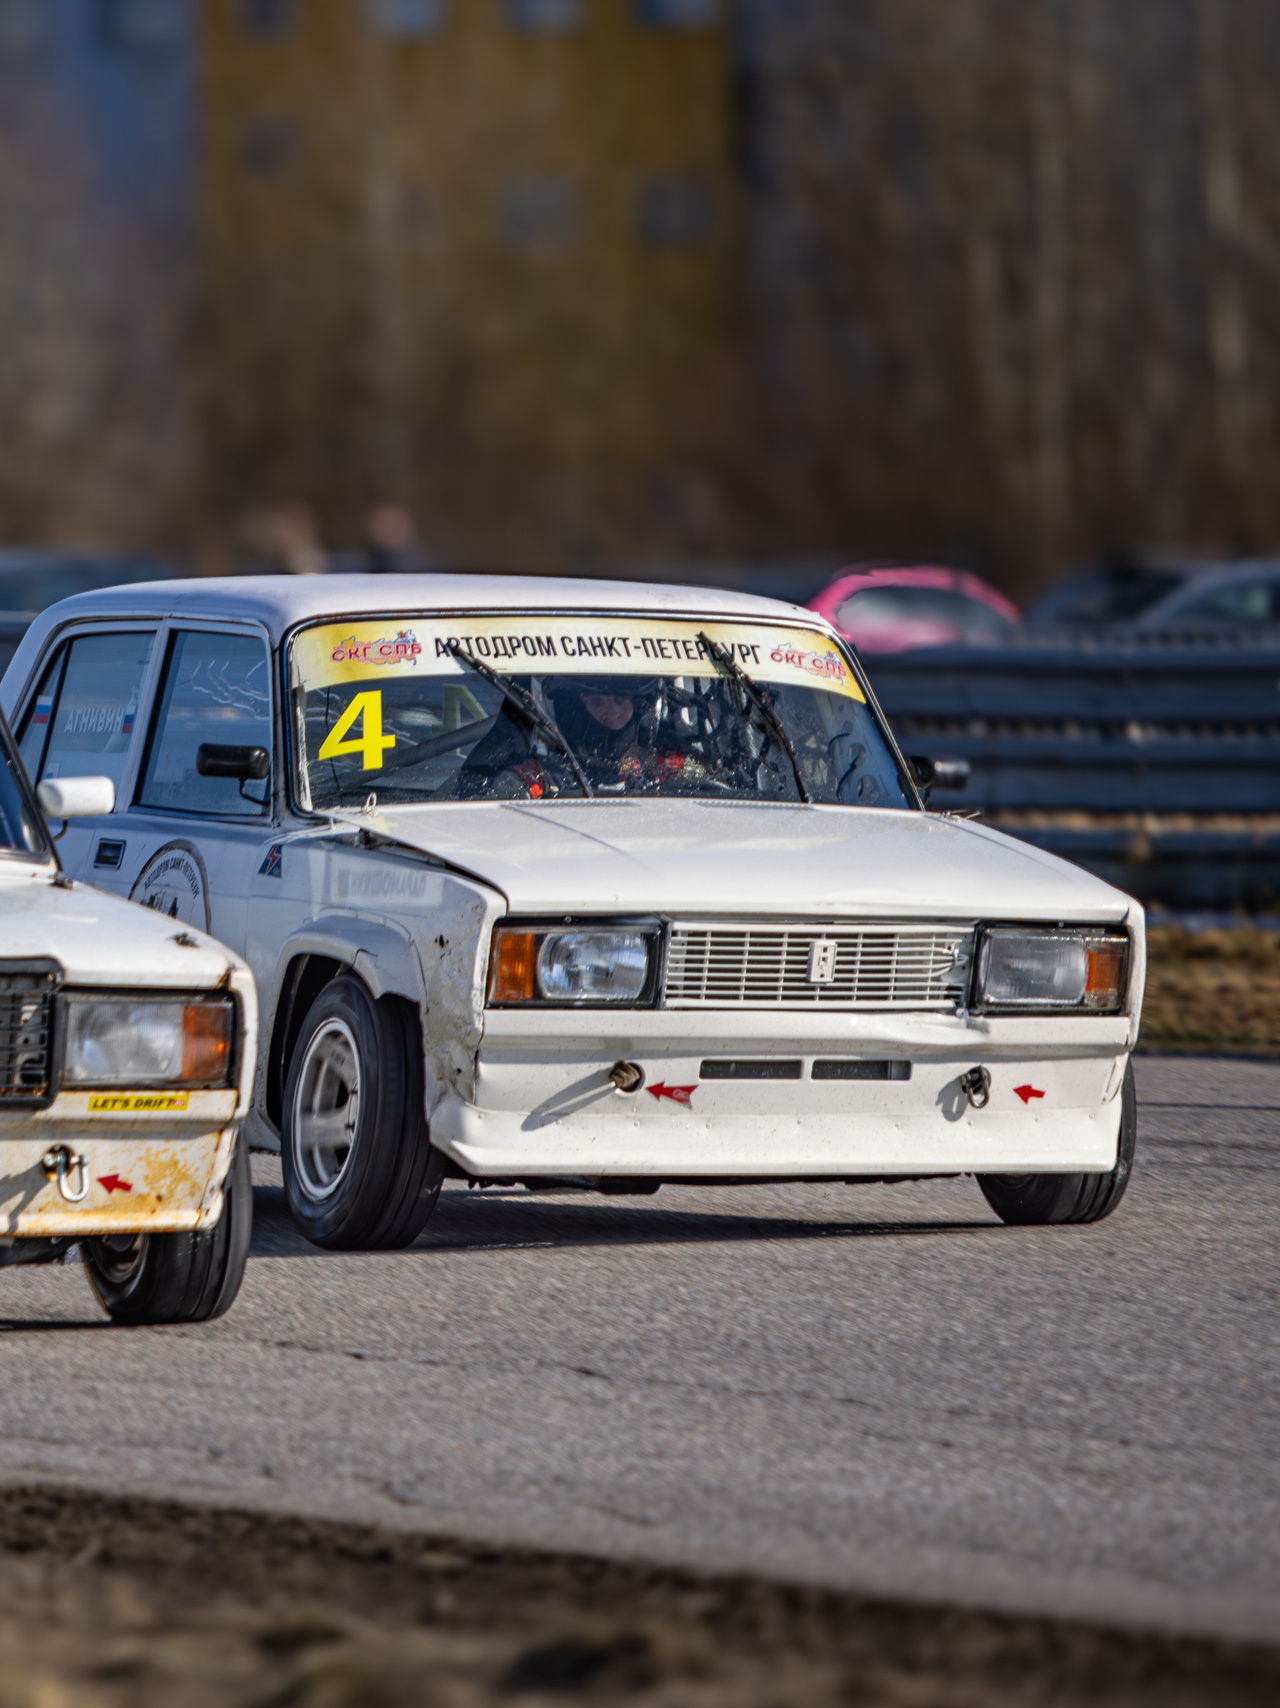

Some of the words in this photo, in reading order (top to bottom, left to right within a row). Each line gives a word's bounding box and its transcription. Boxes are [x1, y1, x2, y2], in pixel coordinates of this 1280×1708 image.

[331, 646, 371, 662] СКГ
[379, 643, 422, 656] СПБ
[812, 658, 847, 677] СПБ
[318, 690, 396, 771] 4
[92, 1098, 131, 1109] LET'S
